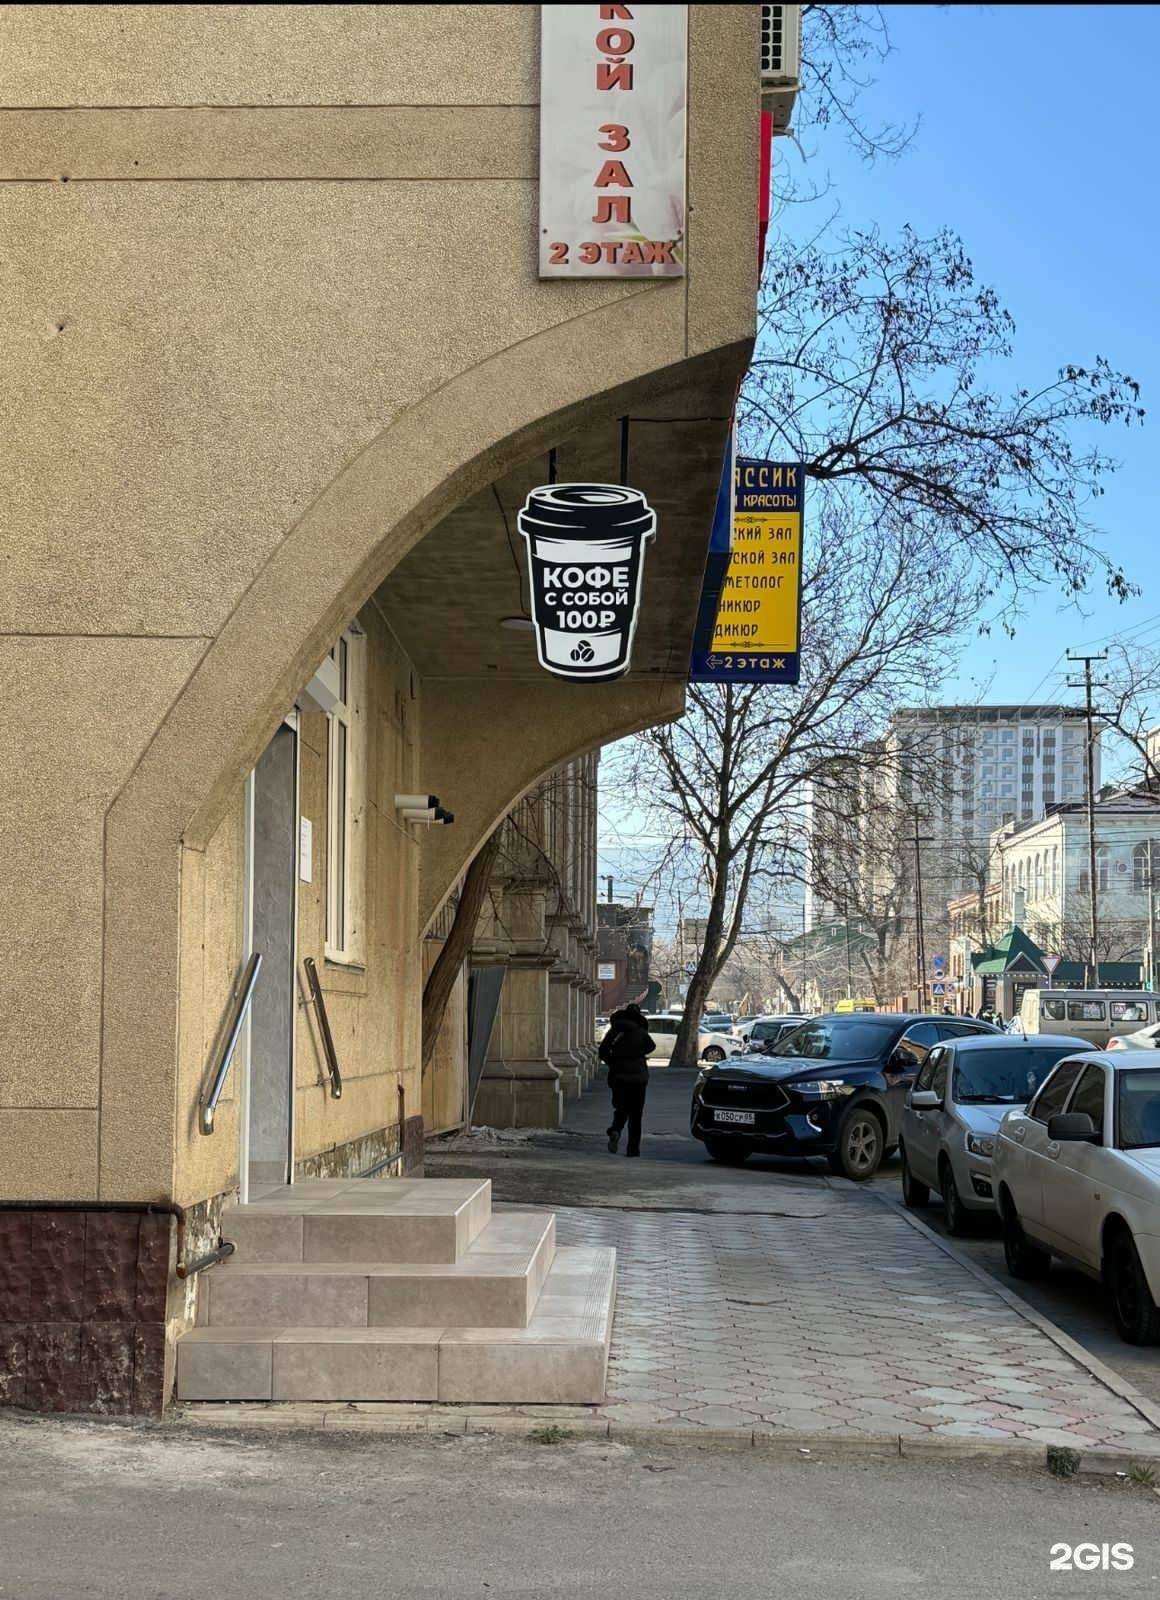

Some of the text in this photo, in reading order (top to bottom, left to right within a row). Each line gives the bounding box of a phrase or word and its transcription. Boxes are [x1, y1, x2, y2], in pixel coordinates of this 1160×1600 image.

[592, 124, 633, 224] ЗАЛ
[549, 241, 676, 264] 2 ЭТАЖ
[743, 495, 797, 507] КРАСОТЫ
[768, 528, 792, 540] ЗАЛ
[771, 552, 795, 564] ЗАЛ
[543, 566, 630, 588] КОФЕ
[544, 588, 628, 606] С СОБОЙ
[715, 624, 758, 638] ДИКЮР
[724, 656, 786, 668] 2 этаж
